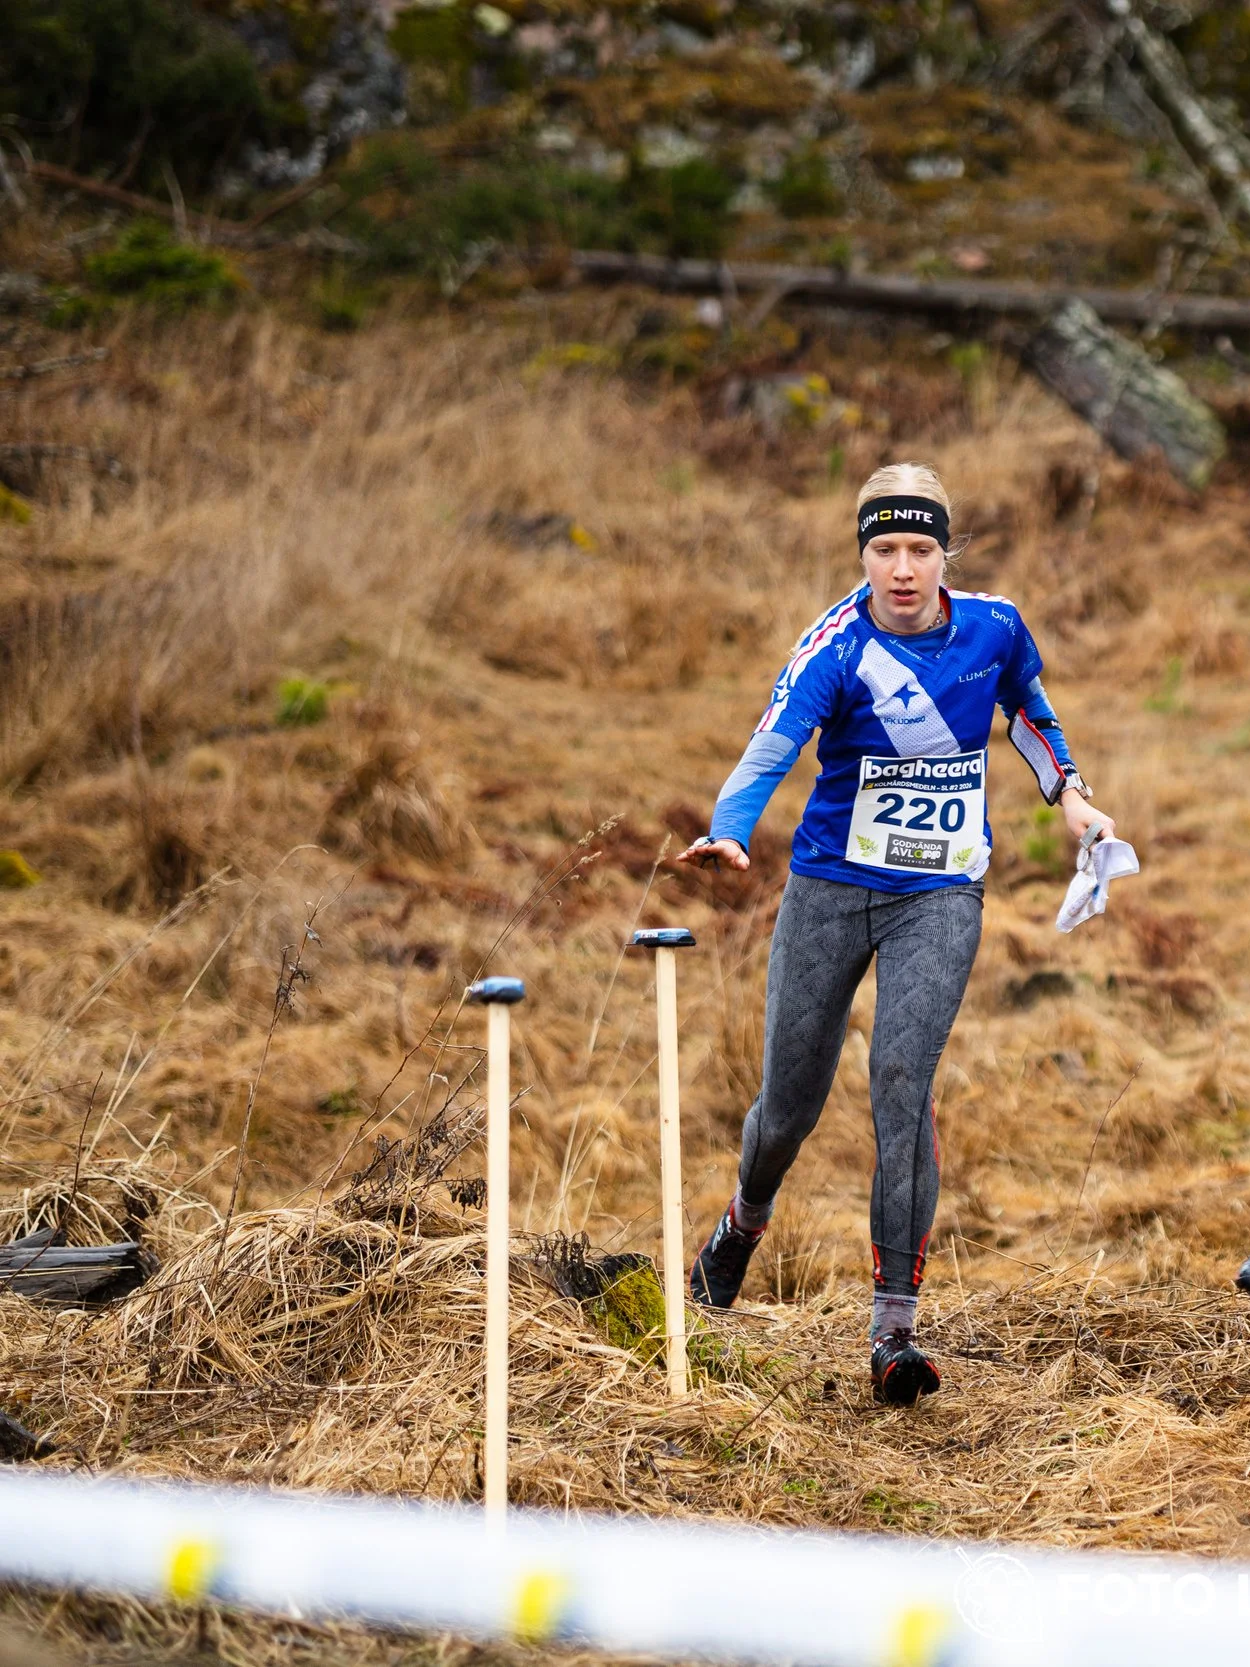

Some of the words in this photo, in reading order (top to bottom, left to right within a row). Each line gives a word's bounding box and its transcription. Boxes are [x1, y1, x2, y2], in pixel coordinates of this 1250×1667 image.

[860, 509, 933, 532] LUMONITE
[865, 758, 982, 780] bagheera
[874, 780, 936, 791] KOLMÅRDSMEDELN
[959, 782, 973, 790] 2026
[873, 793, 966, 833] 220
[891, 847, 941, 860] AVLOPP
[892, 839, 943, 851] GODKÄNDA
